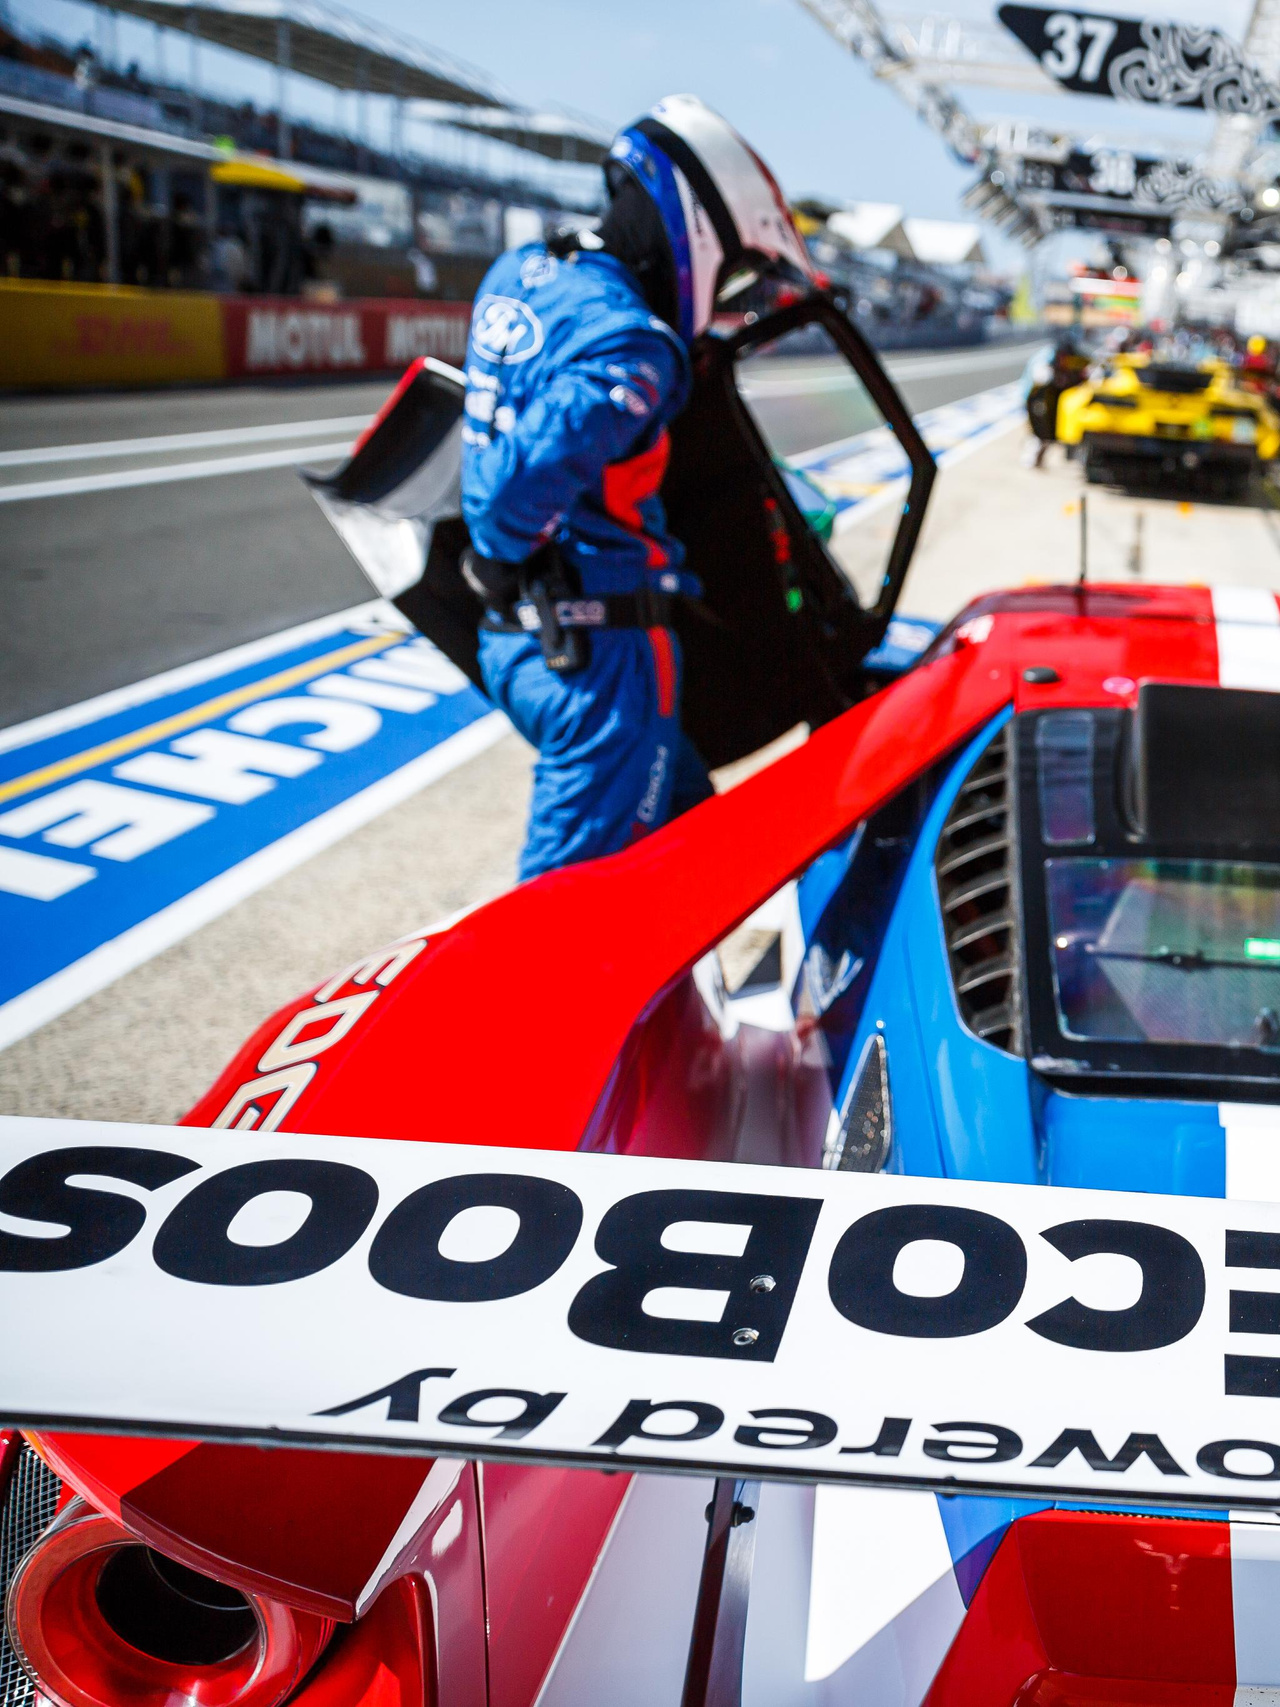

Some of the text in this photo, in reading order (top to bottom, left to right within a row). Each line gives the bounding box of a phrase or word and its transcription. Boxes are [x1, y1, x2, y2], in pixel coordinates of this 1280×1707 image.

[1042, 12, 1118, 82] 37
[247, 311, 366, 367] MOTUL
[387, 313, 468, 358] MOTU
[308, 1367, 568, 1440] by
